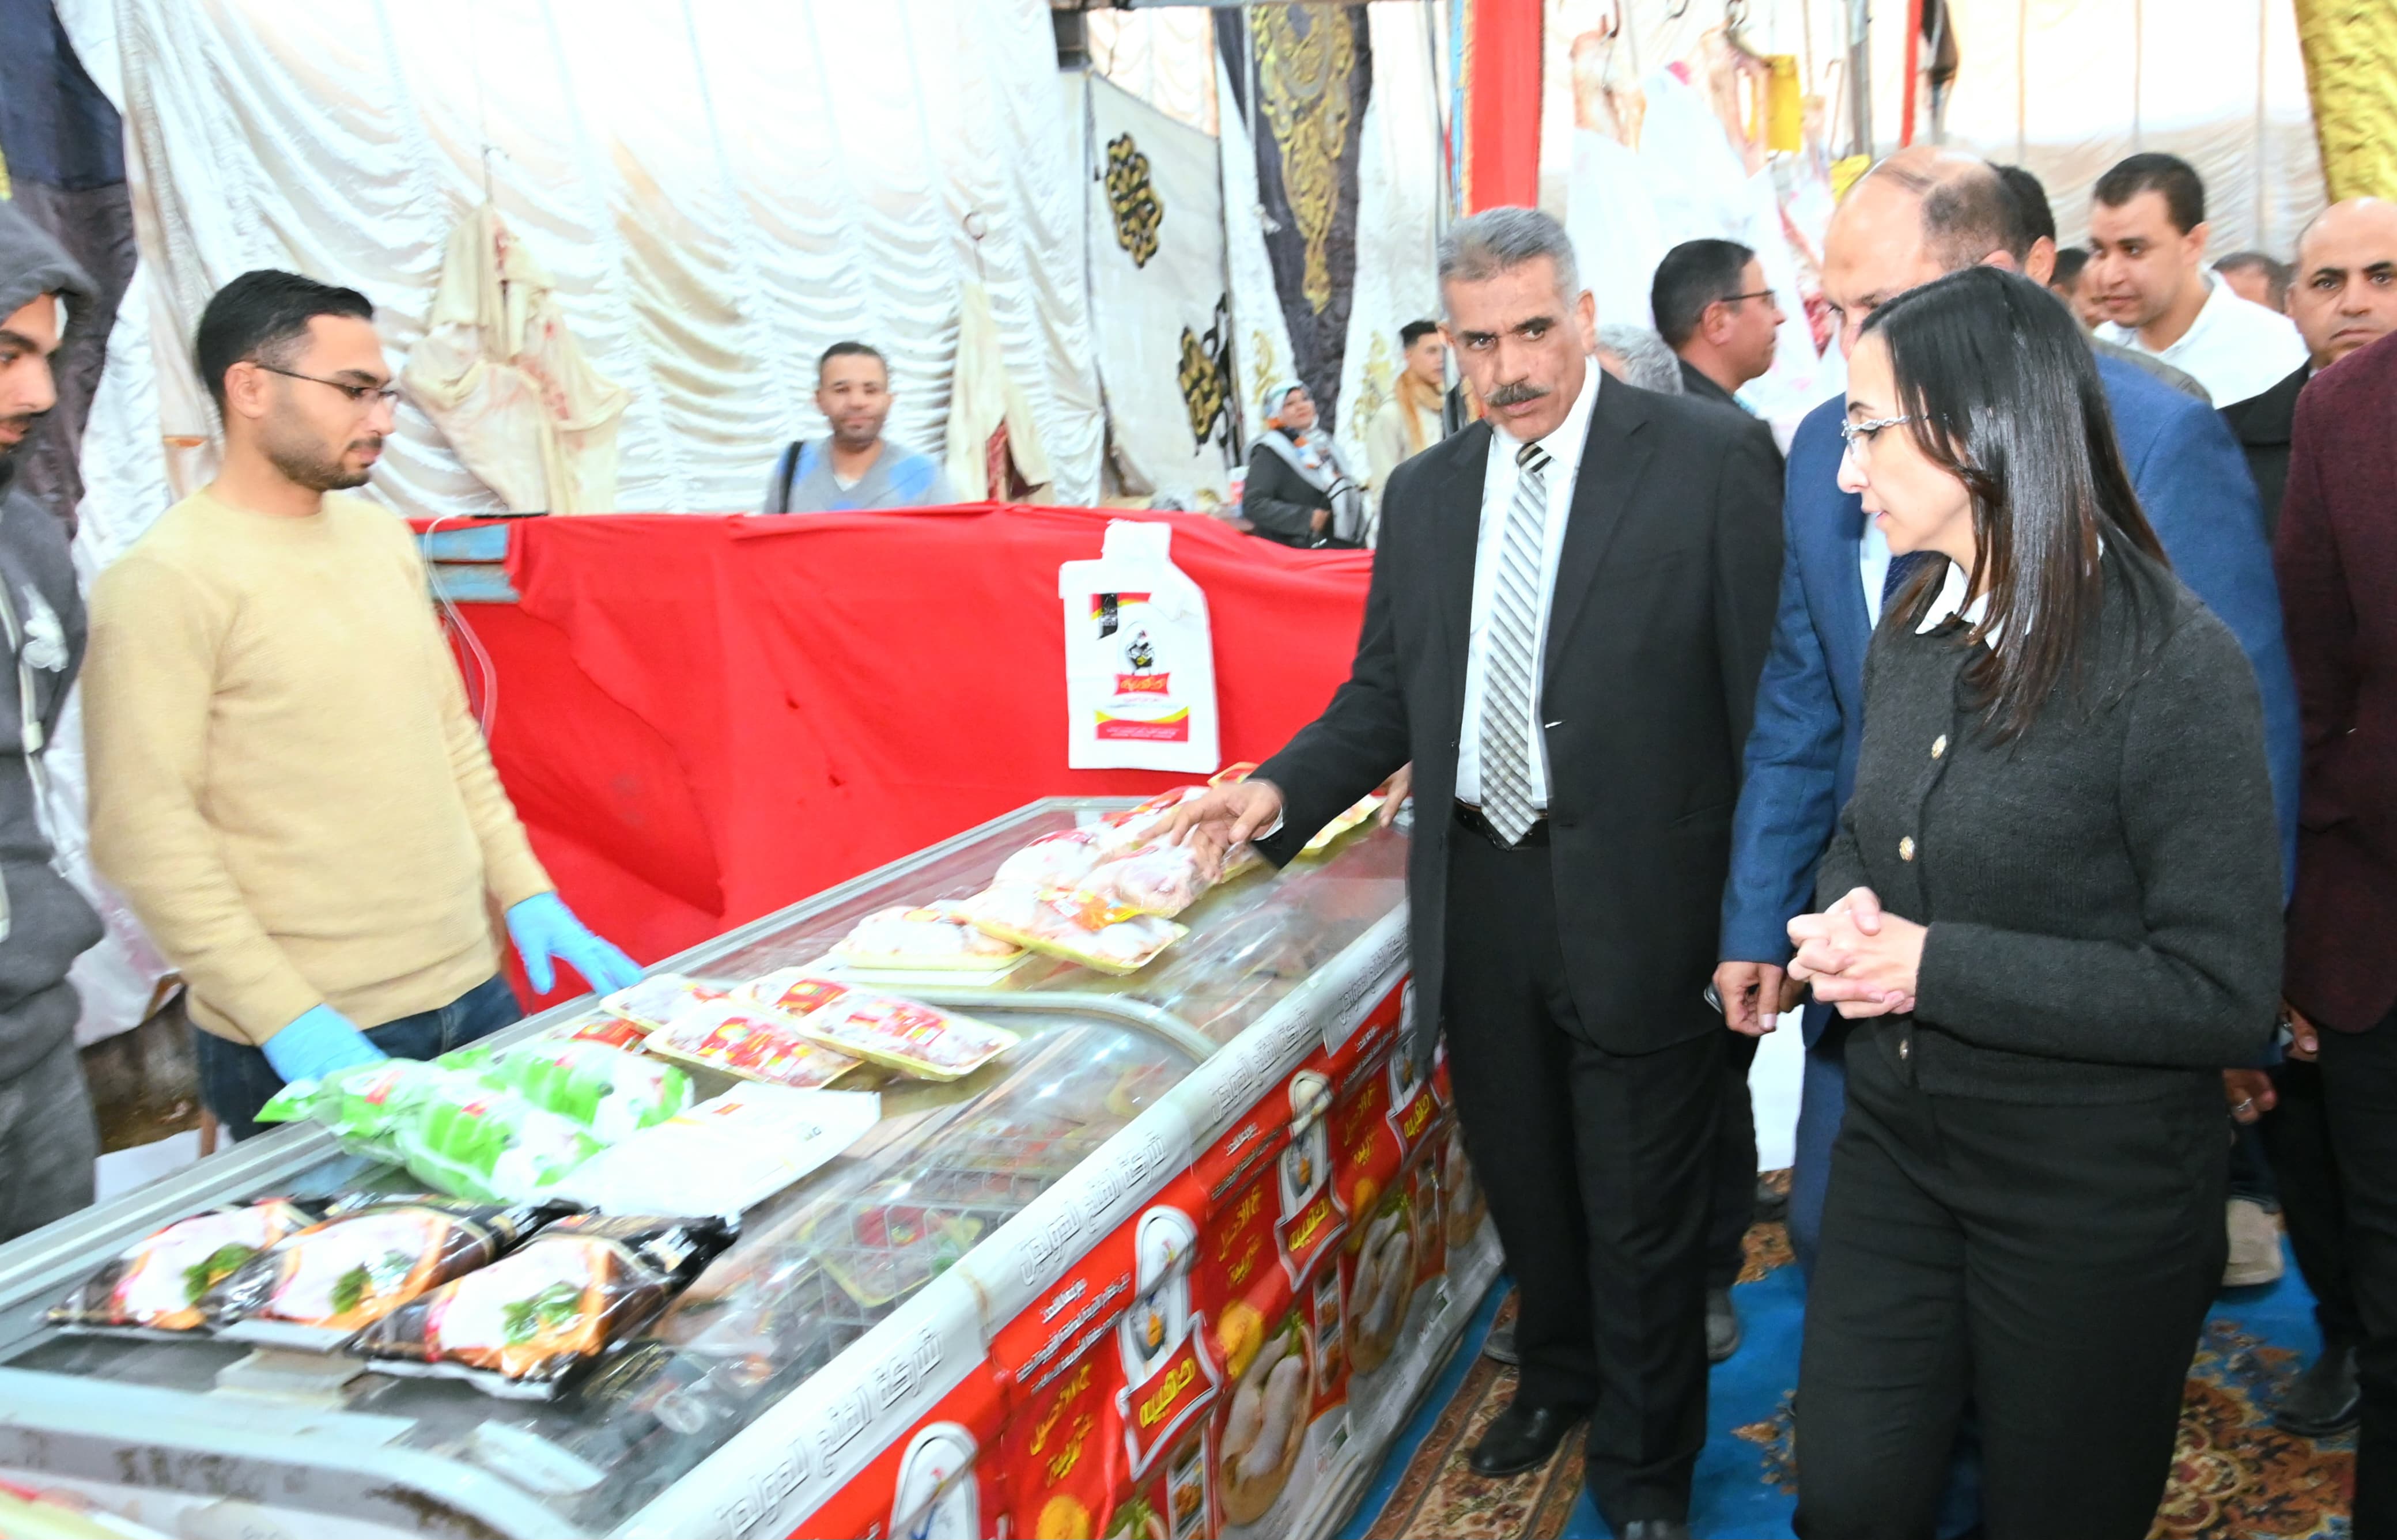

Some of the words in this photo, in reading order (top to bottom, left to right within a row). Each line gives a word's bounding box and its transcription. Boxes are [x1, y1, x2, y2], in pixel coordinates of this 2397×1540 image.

[1277, 1007, 1311, 1054] شركة
[1252, 1039, 1279, 1088] الفتح
[1117, 1131, 1166, 1190] شركة
[1083, 1168, 1120, 1233] الفتح
[874, 1327, 944, 1409] شركة
[818, 1383, 872, 1478] الفتح
[714, 1437, 809, 1540] للدواج
